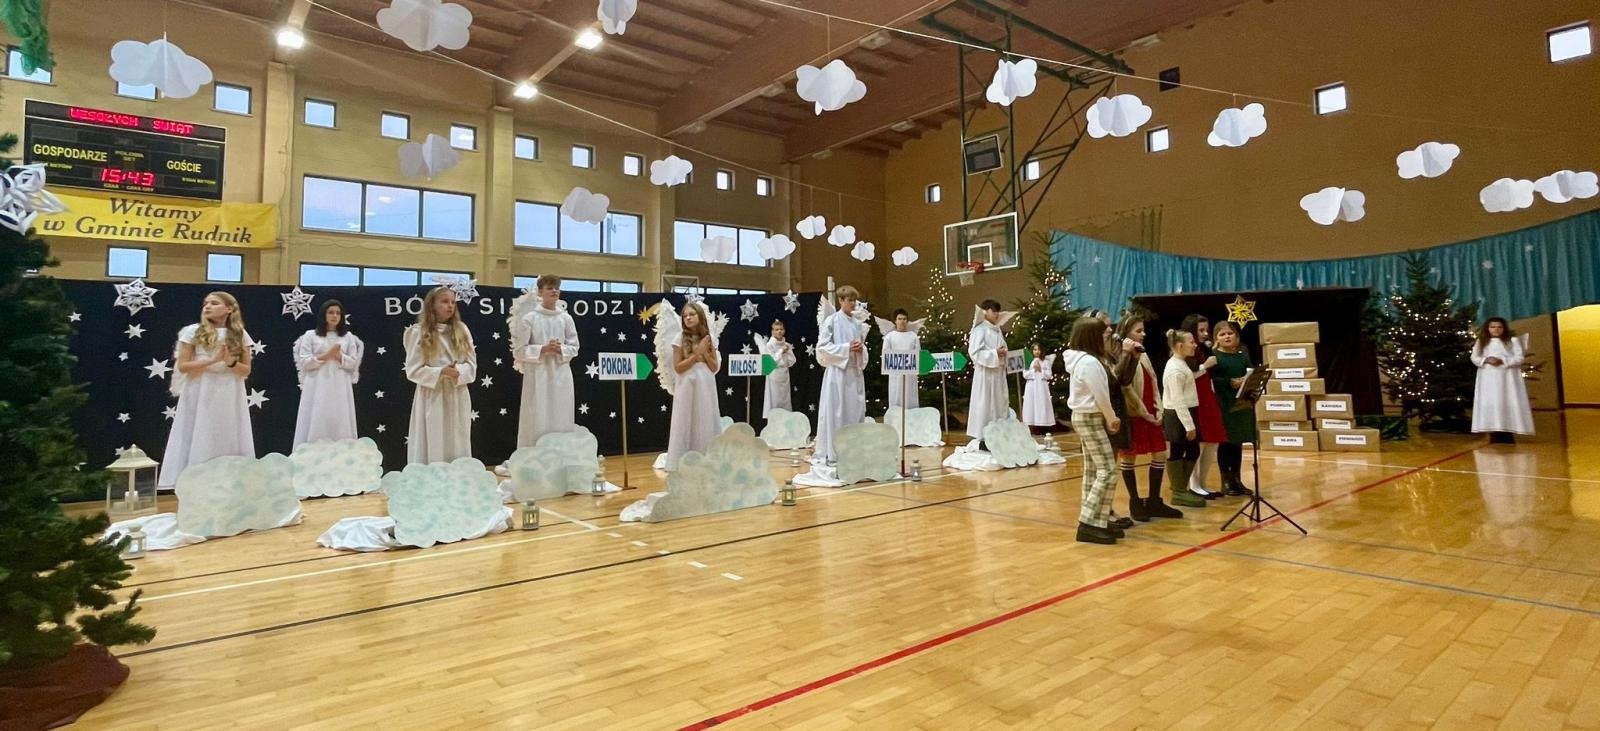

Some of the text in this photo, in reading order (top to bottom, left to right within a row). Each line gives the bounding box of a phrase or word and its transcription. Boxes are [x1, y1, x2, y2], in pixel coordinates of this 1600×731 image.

[33, 143, 108, 162] GOSPODARZE
[166, 160, 202, 173] GOŚCIE
[102, 168, 154, 187] 15:43
[110, 197, 203, 223] Witamy
[43, 216, 252, 244] w Gminie Rudnik
[384, 293, 425, 315] BÓ
[479, 297, 505, 315] SI
[601, 357, 633, 375] POKORA
[884, 352, 917, 371] NADZIEJA
